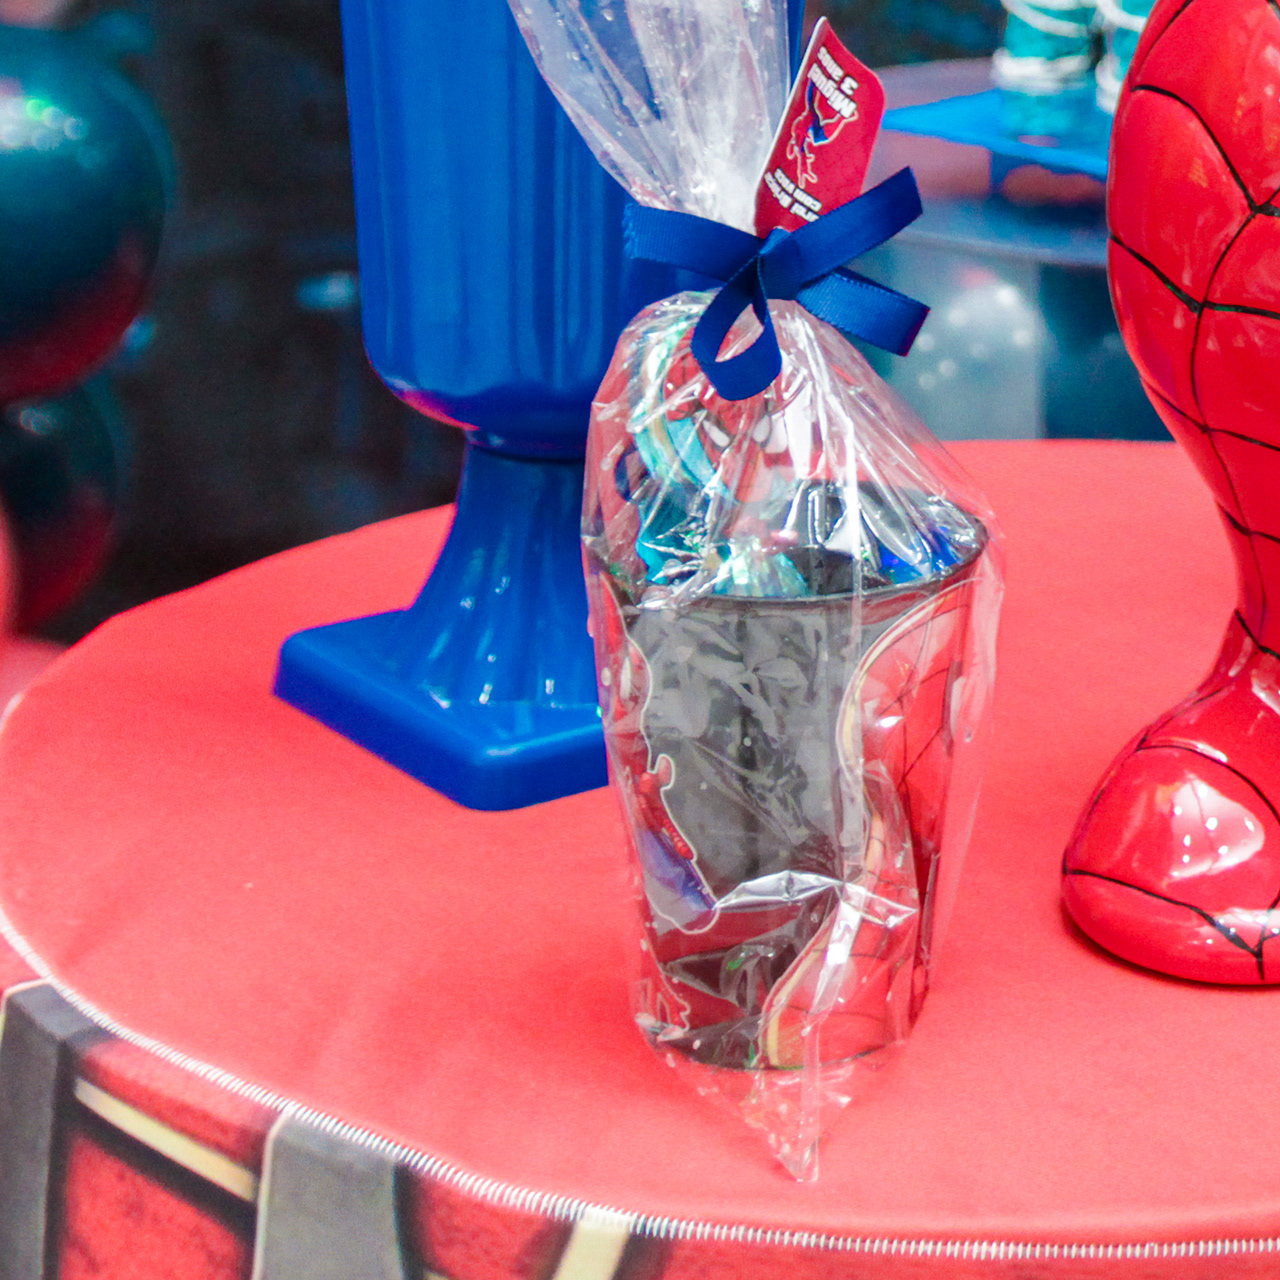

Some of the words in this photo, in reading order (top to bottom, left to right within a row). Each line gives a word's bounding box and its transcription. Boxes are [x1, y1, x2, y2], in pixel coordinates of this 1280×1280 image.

[817, 46, 845, 82] anos
[807, 63, 858, 118] Miguel
[841, 75, 859, 97] 3
[793, 188, 822, 213] com
